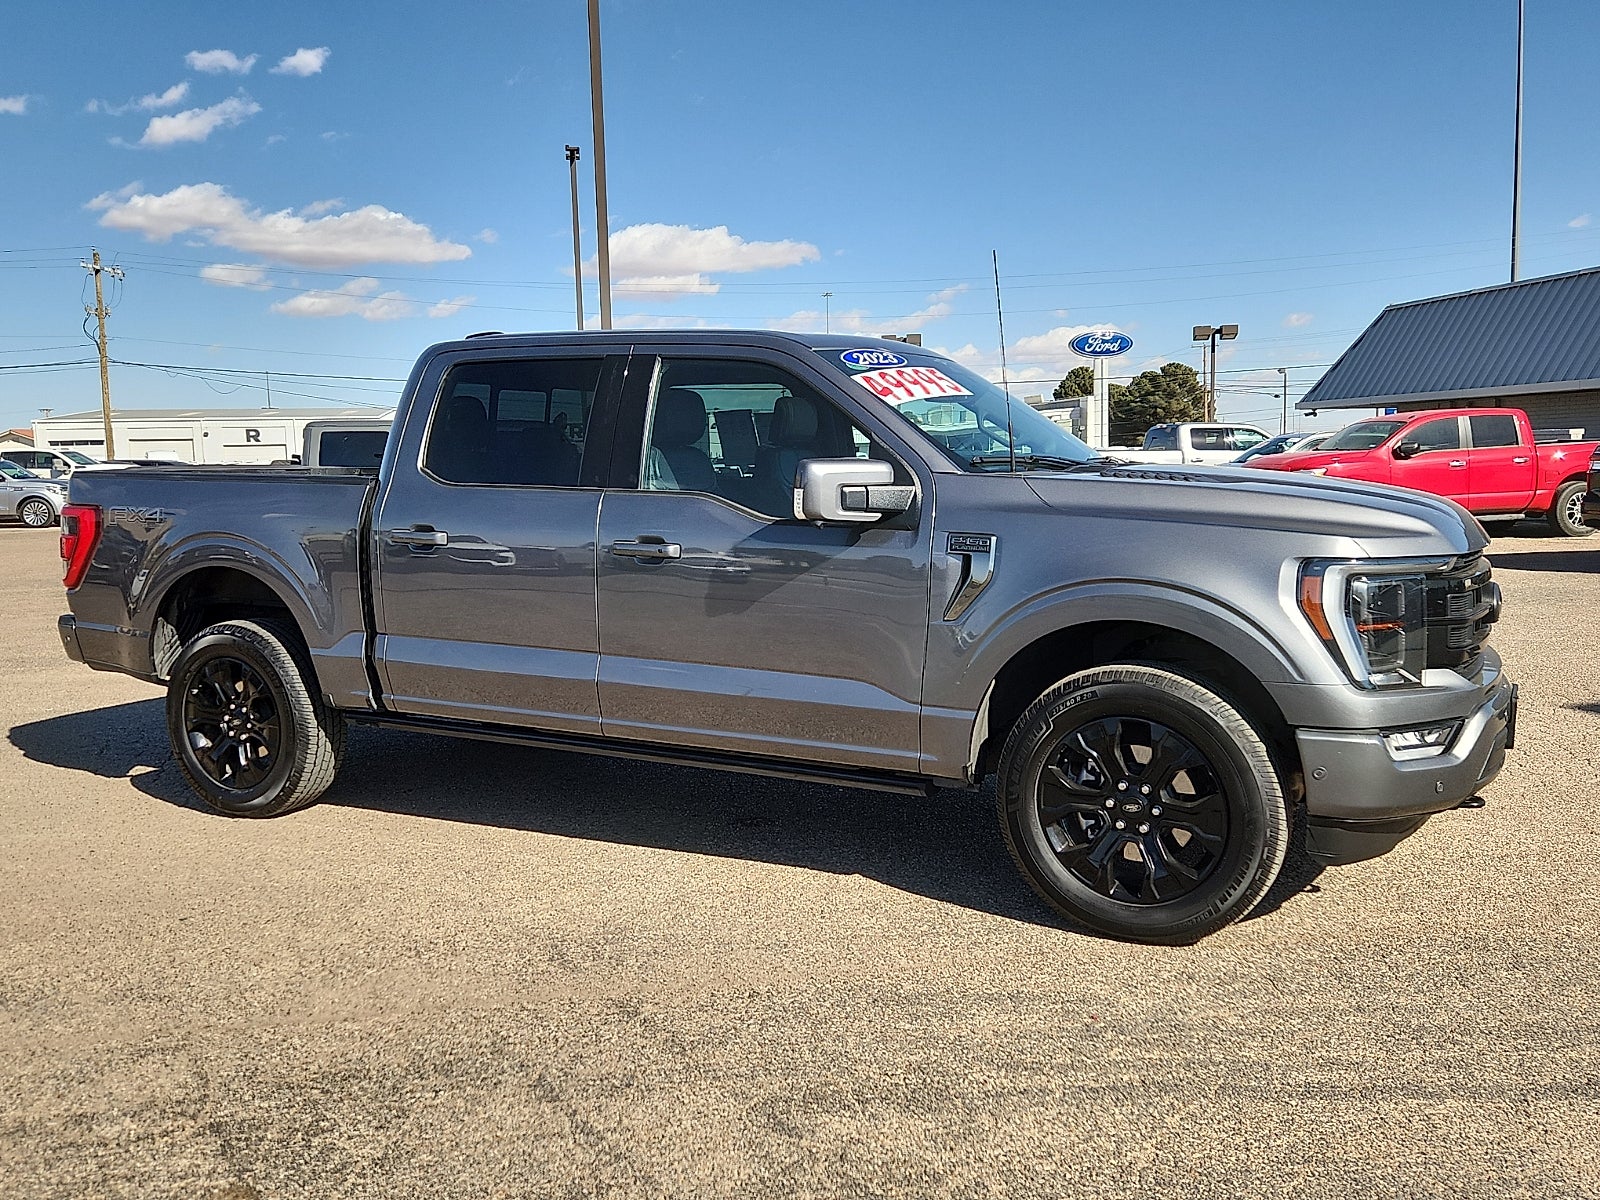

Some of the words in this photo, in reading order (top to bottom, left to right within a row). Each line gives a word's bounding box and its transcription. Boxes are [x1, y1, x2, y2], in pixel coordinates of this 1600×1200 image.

[1085, 334, 1121, 352] Ford
[853, 352, 898, 365] 2023
[861, 368, 963, 400] 49995
[246, 429, 261, 442] R
[109, 506, 164, 526] FX4
[951, 536, 990, 546] F-150
